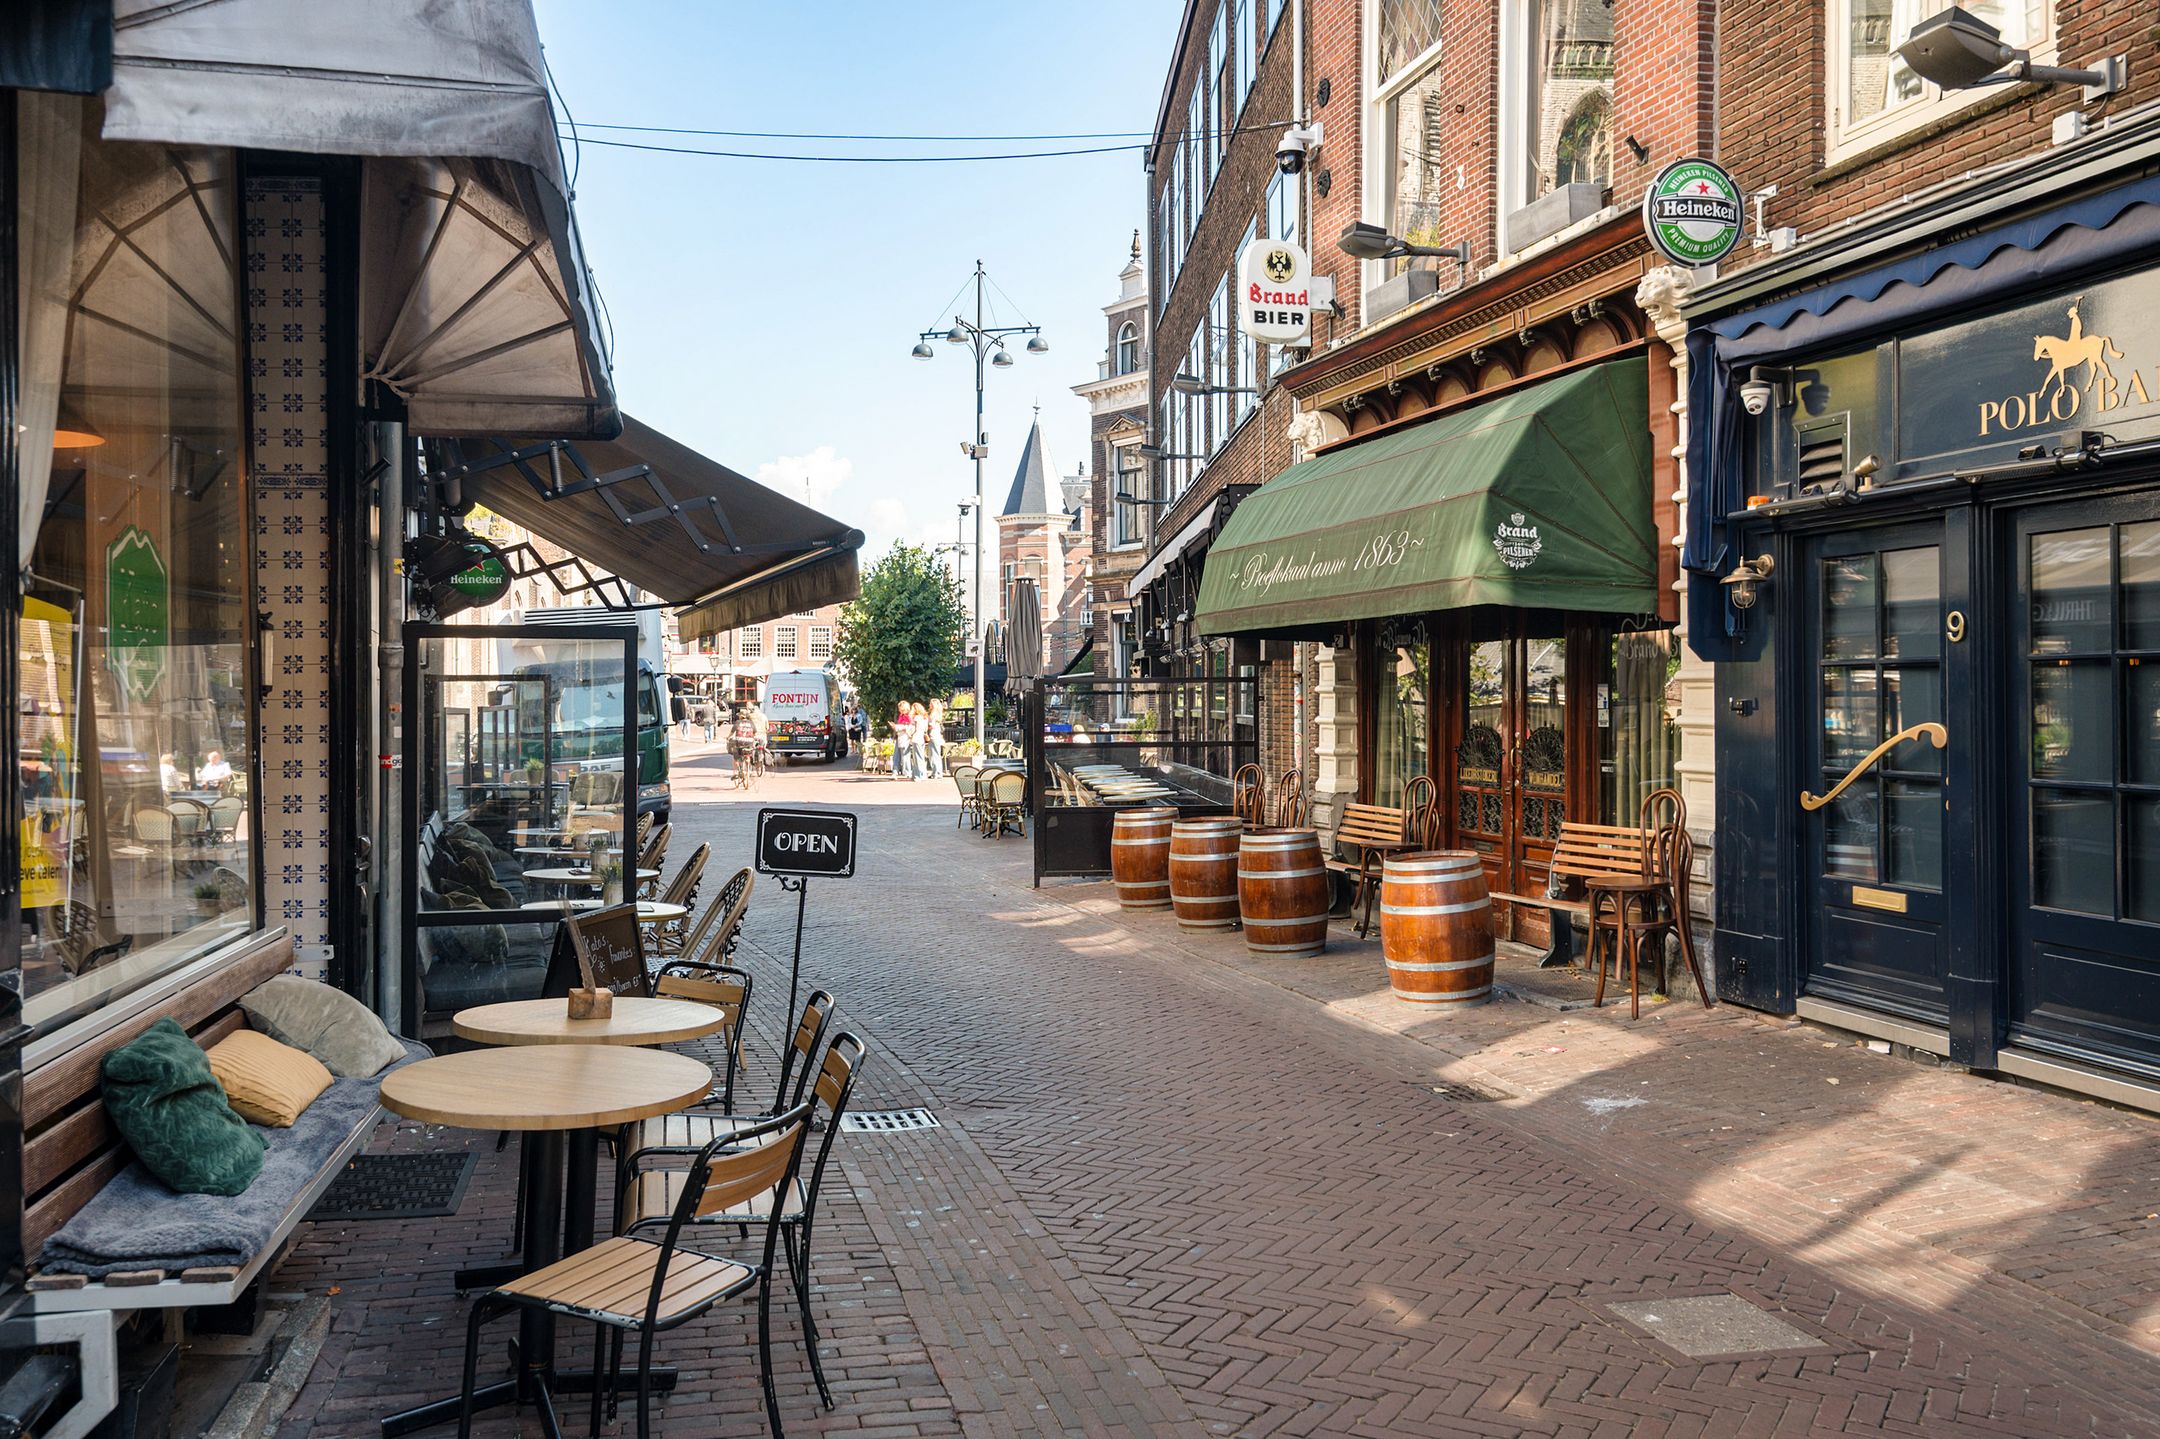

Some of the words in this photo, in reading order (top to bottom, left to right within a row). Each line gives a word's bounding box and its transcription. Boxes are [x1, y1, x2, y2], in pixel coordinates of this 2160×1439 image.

[1668, 169, 1701, 190] HEINEKEN
[1702, 170, 1729, 193] PILSENER
[1663, 200, 1735, 221] Heineken
[1667, 228, 1700, 253] PREMIUM
[1702, 231, 1730, 253] QUALITY
[1249, 282, 1309, 306] Brand
[1254, 310, 1304, 326] BIER
[1978, 384, 2081, 437] POLO
[1497, 522, 1538, 538] Brand
[1502, 546, 1535, 557] PILSENER
[1240, 551, 1316, 598] Proeflokaal
[1310, 557, 1348, 578] anno
[1353, 530, 1409, 572] 1863
[450, 574, 503, 584] Heineken
[1946, 610, 1965, 642] 9
[771, 692, 819, 706] FONTIJN
[773, 832, 839, 854] OPEN
